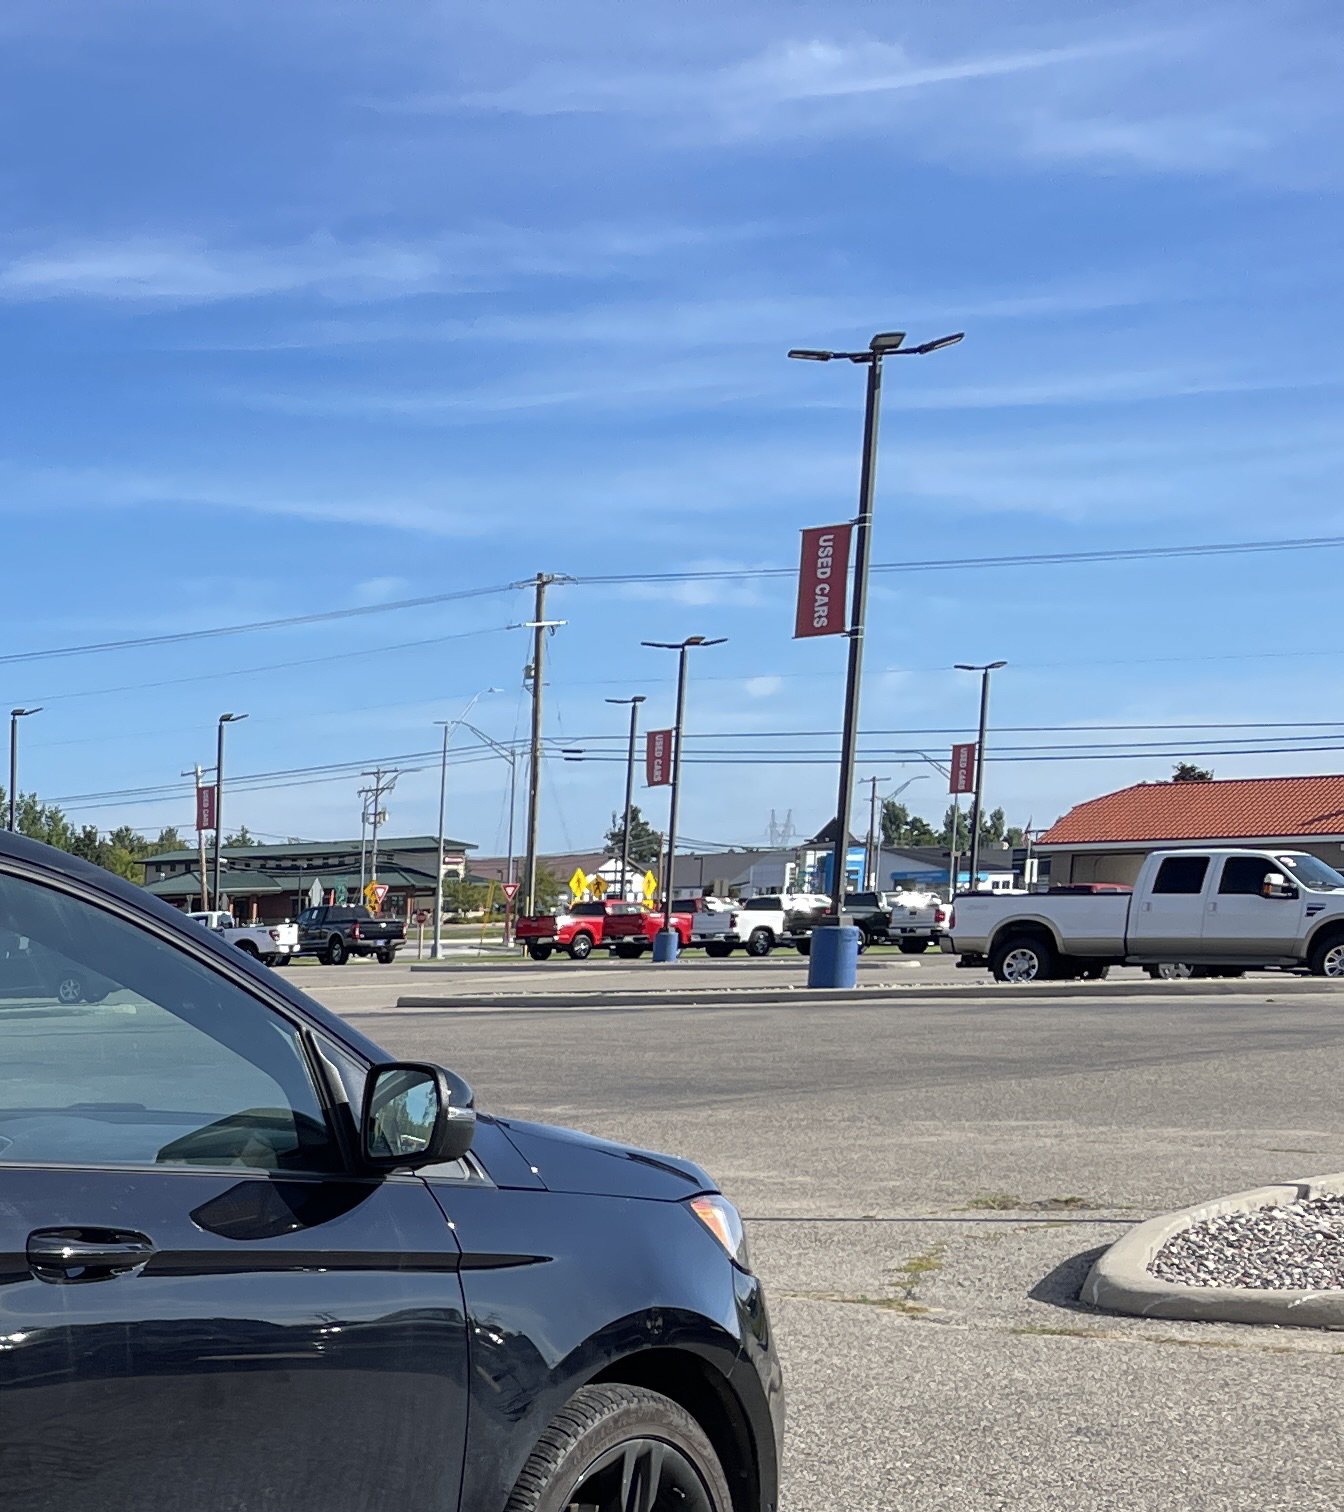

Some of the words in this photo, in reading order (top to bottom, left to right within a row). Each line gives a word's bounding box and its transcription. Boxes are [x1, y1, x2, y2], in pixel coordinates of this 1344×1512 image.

[817, 534, 834, 579] USED
[813, 583, 830, 628] CARS
[655, 734, 664, 758] USED
[959, 747, 968, 768] USED
[653, 758, 663, 782] CARS
[957, 769, 967, 790] CARS
